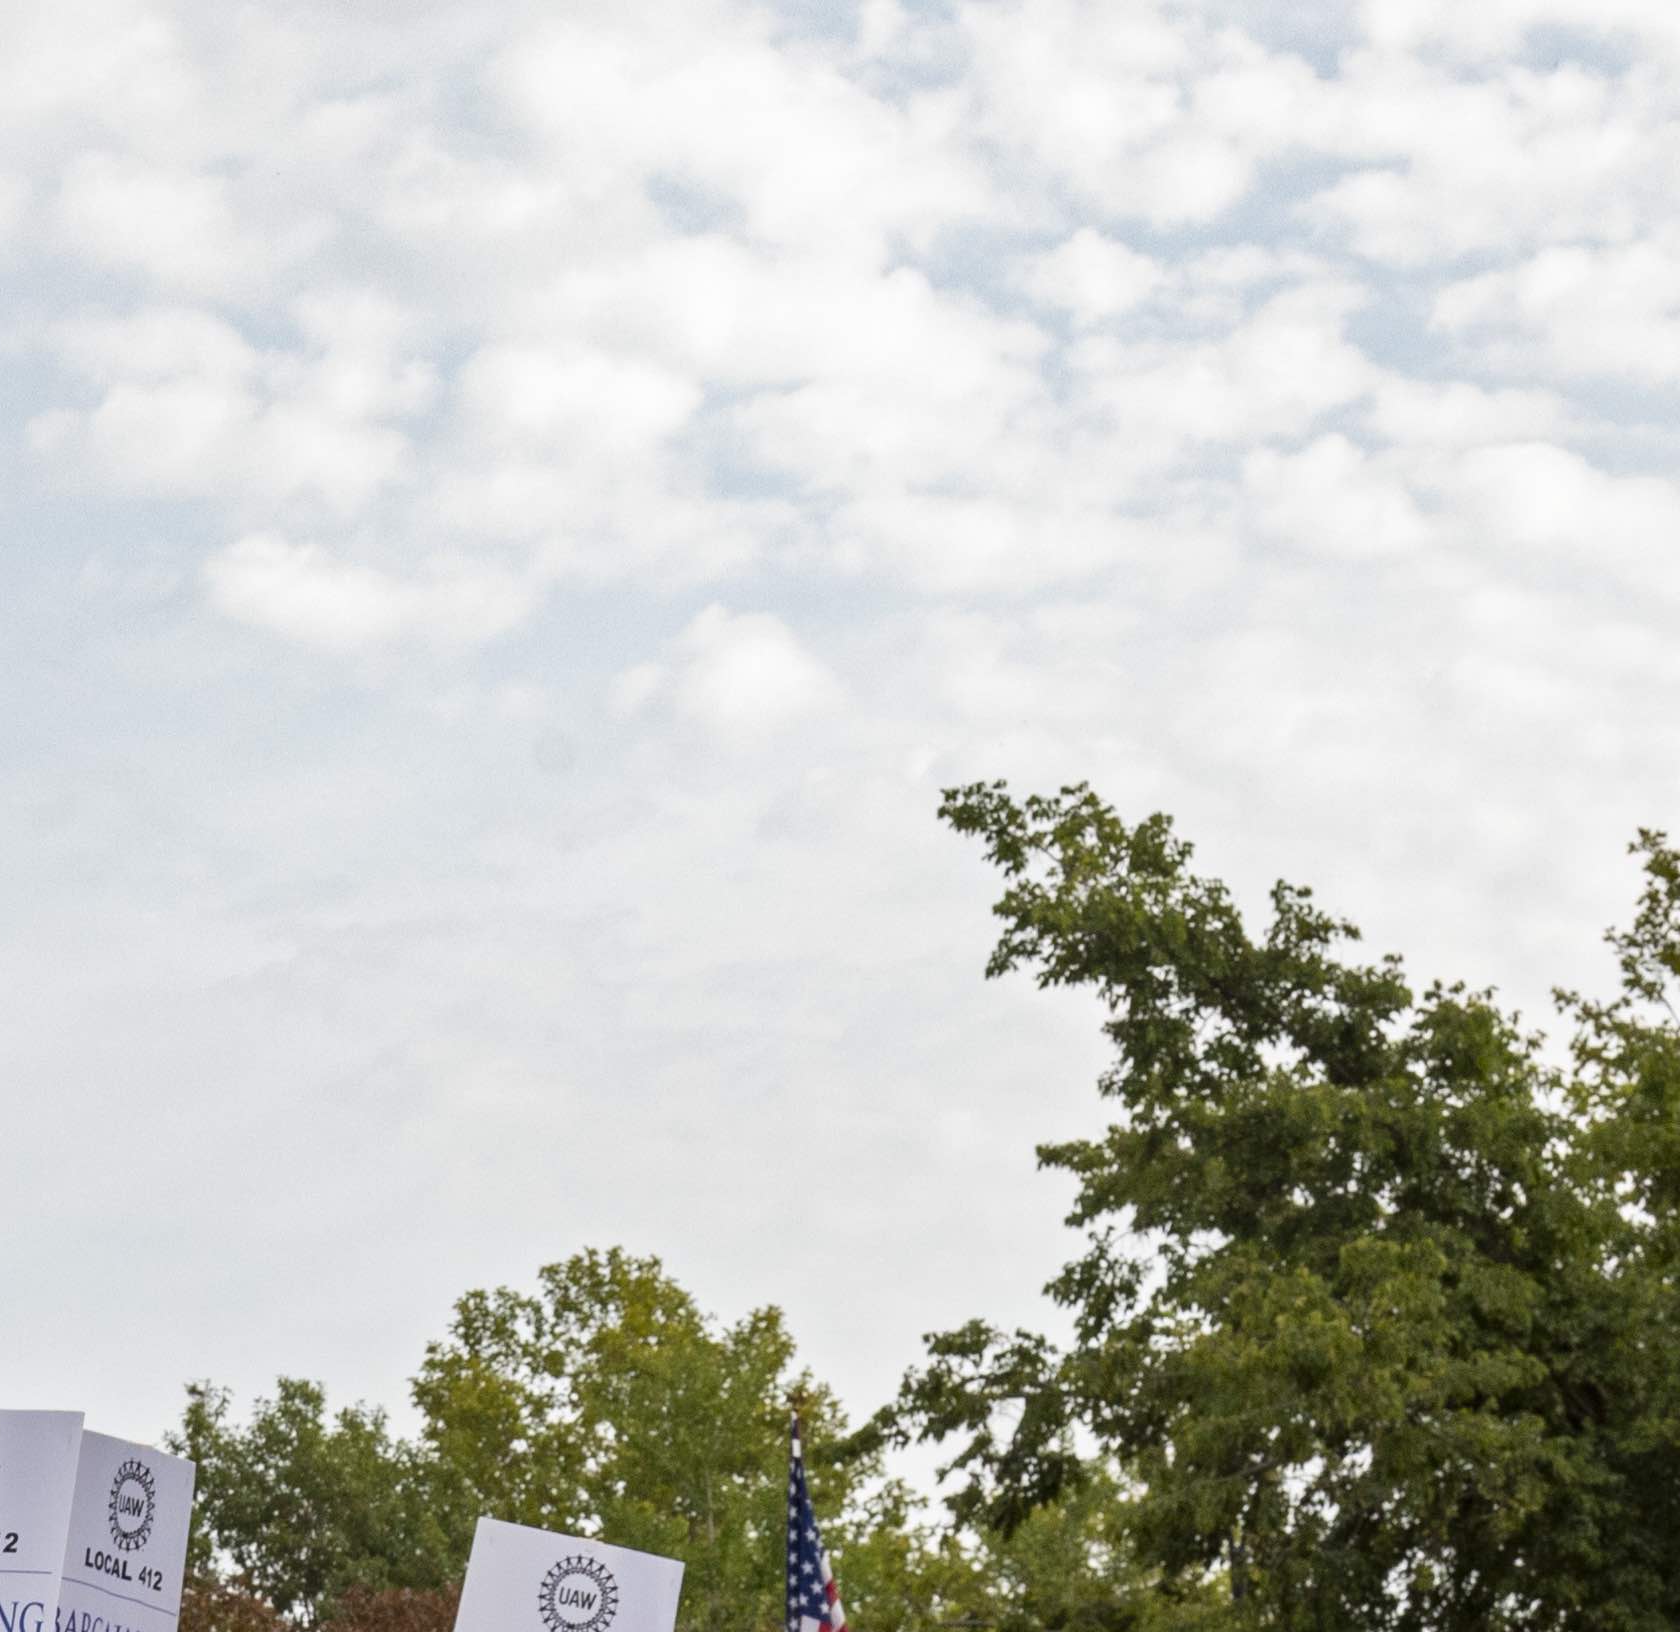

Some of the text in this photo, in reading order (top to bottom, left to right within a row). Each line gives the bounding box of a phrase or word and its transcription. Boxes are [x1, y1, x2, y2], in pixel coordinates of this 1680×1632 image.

[118, 1494, 145, 1518] UAW
[85, 1547, 163, 1592] LOCAL 412
[558, 1587, 597, 1611] UAW
